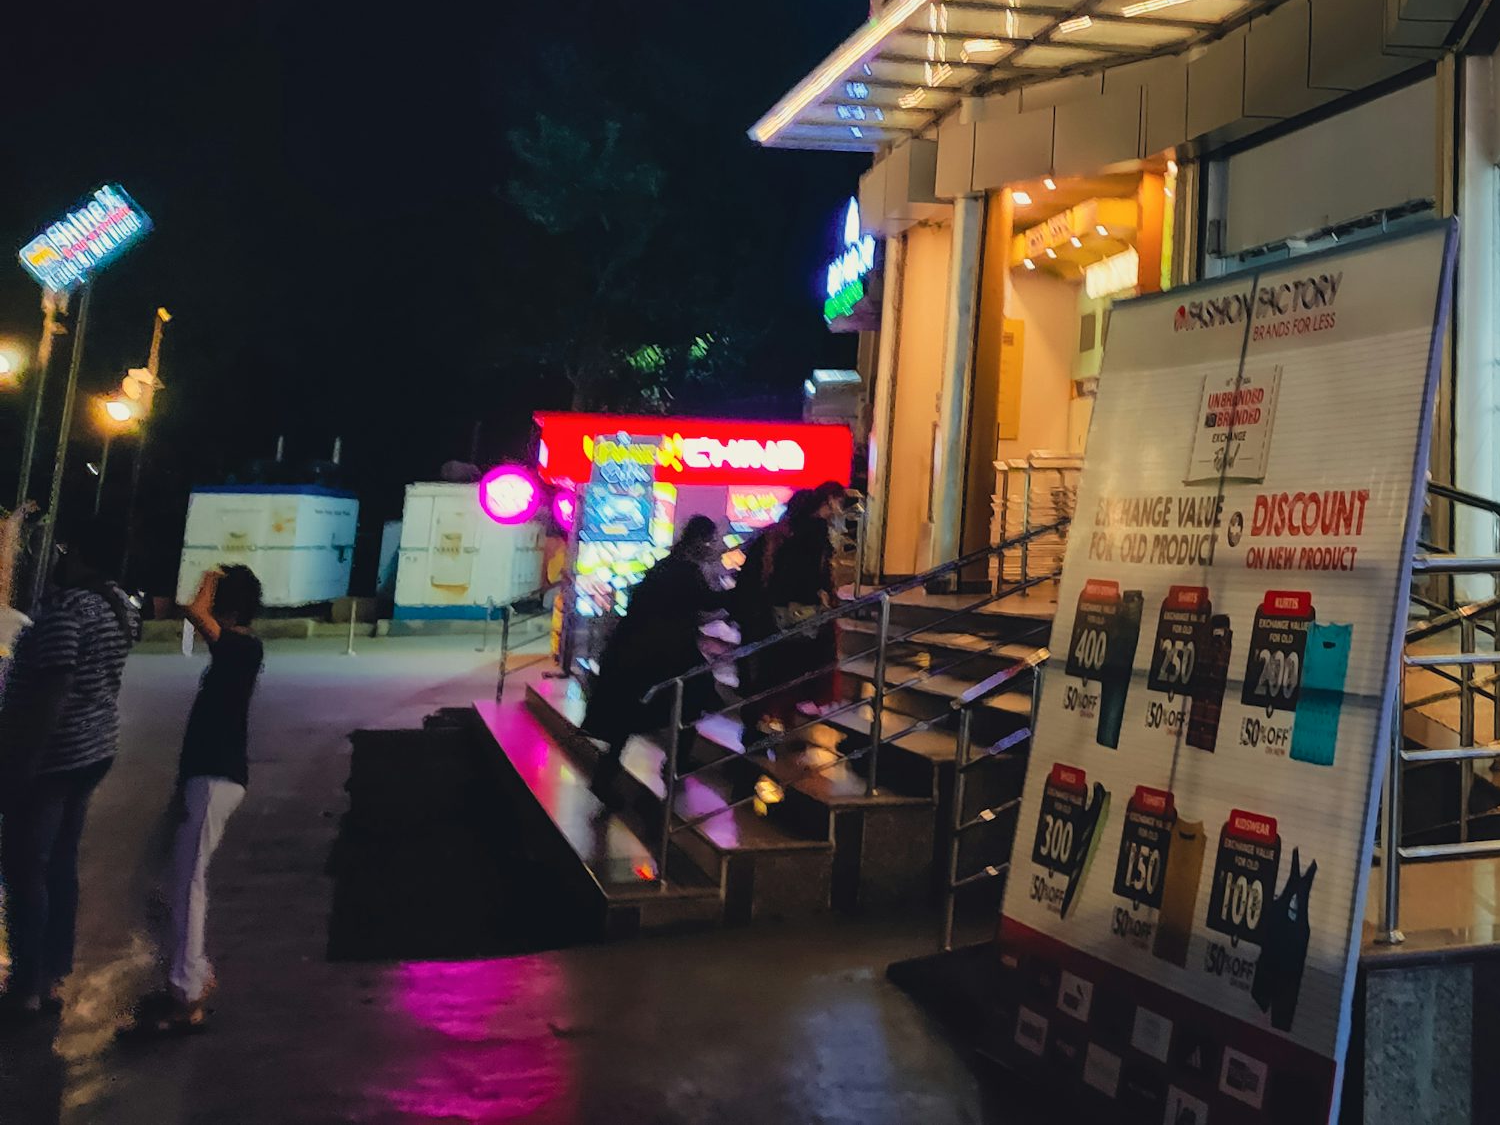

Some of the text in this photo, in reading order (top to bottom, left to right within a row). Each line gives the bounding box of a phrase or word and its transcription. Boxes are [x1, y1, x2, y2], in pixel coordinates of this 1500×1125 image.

[1255, 272, 1343, 319] FACTORY
[1252, 313, 1337, 341] BRANDS FOR LESS
[1207, 388, 1264, 409] UNBRANDED
[1216, 408, 1261, 427] BRANDED
[1094, 494, 1225, 528] EXCHANGE VALUE
[1250, 488, 1371, 537] DISCOUNT
[1120, 533, 1147, 563] OLD
[1150, 533, 1219, 566] PRODUCT
[1246, 546, 1358, 572] ON NEW PRODUCT
